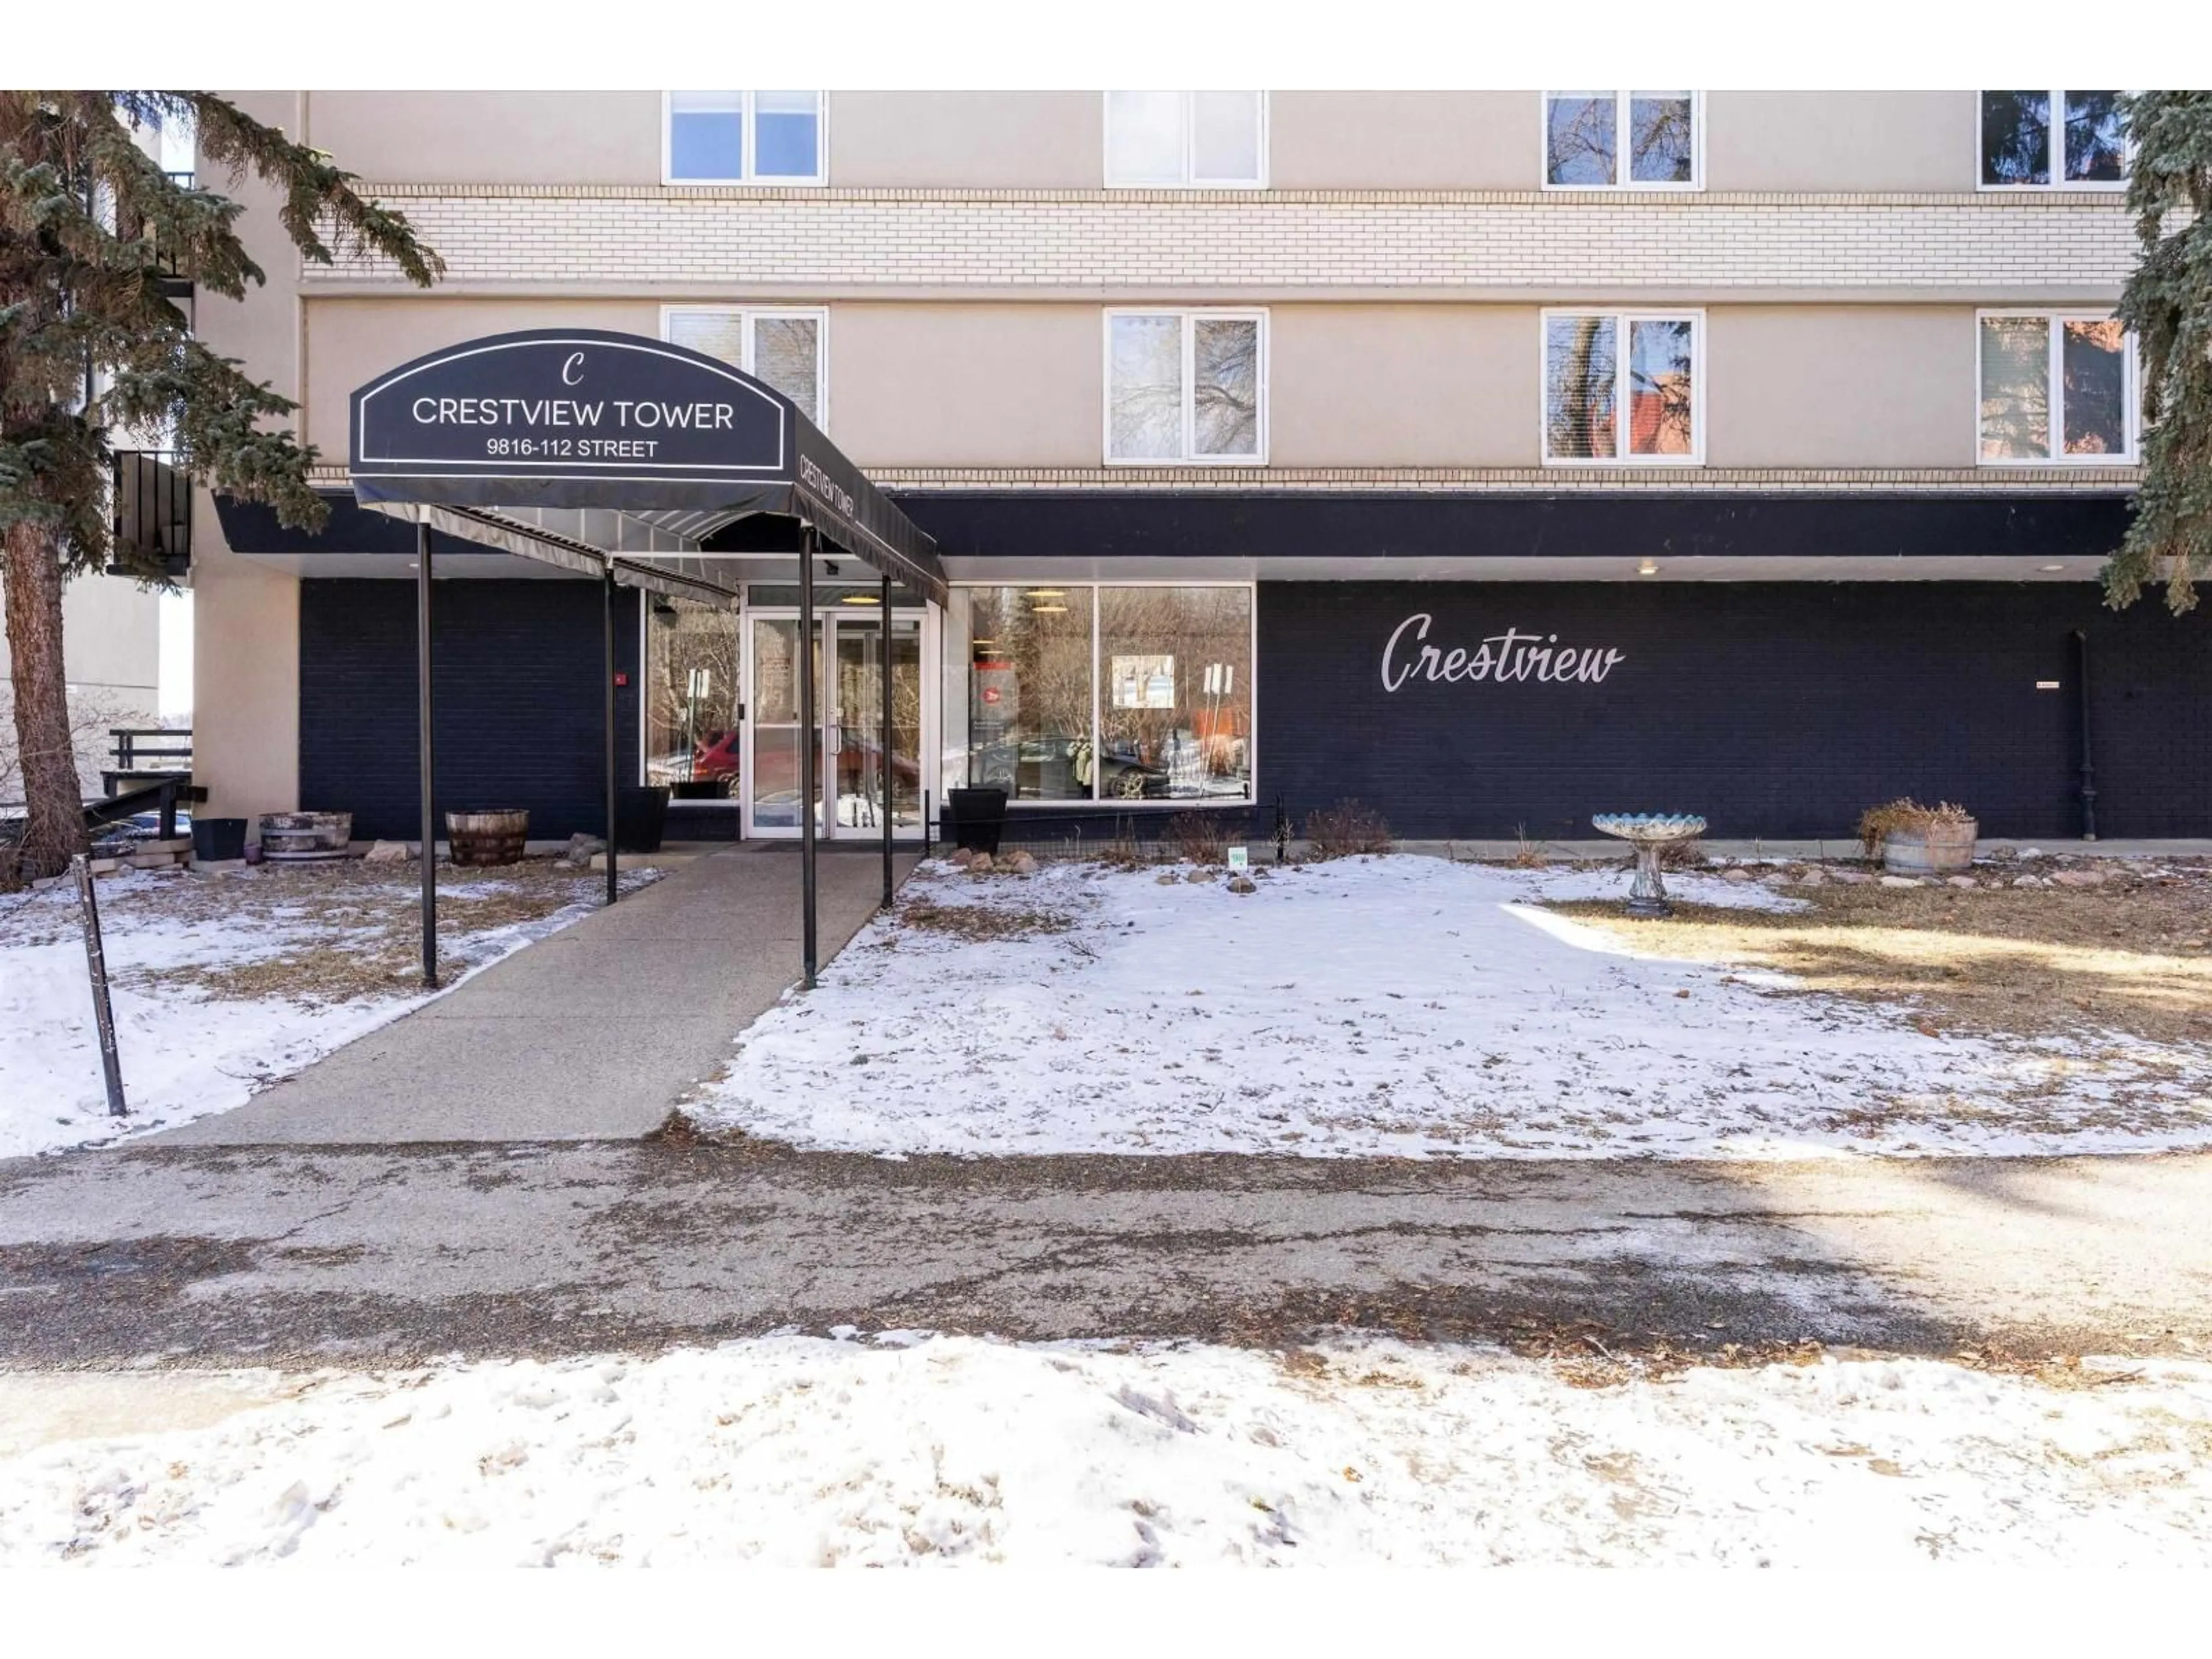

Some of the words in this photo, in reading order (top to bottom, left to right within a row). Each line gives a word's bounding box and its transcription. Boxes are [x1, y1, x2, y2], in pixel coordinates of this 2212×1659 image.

[562, 352, 584, 385] C
[412, 397, 604, 427] CRESTVIEW
[613, 401, 733, 429] TOWER
[487, 438, 572, 456] 9816-112
[577, 440, 658, 458] STREET
[800, 454, 835, 502] CRESTVIEW
[834, 484, 854, 518] TOWER
[1381, 613, 1626, 692] Crestview
